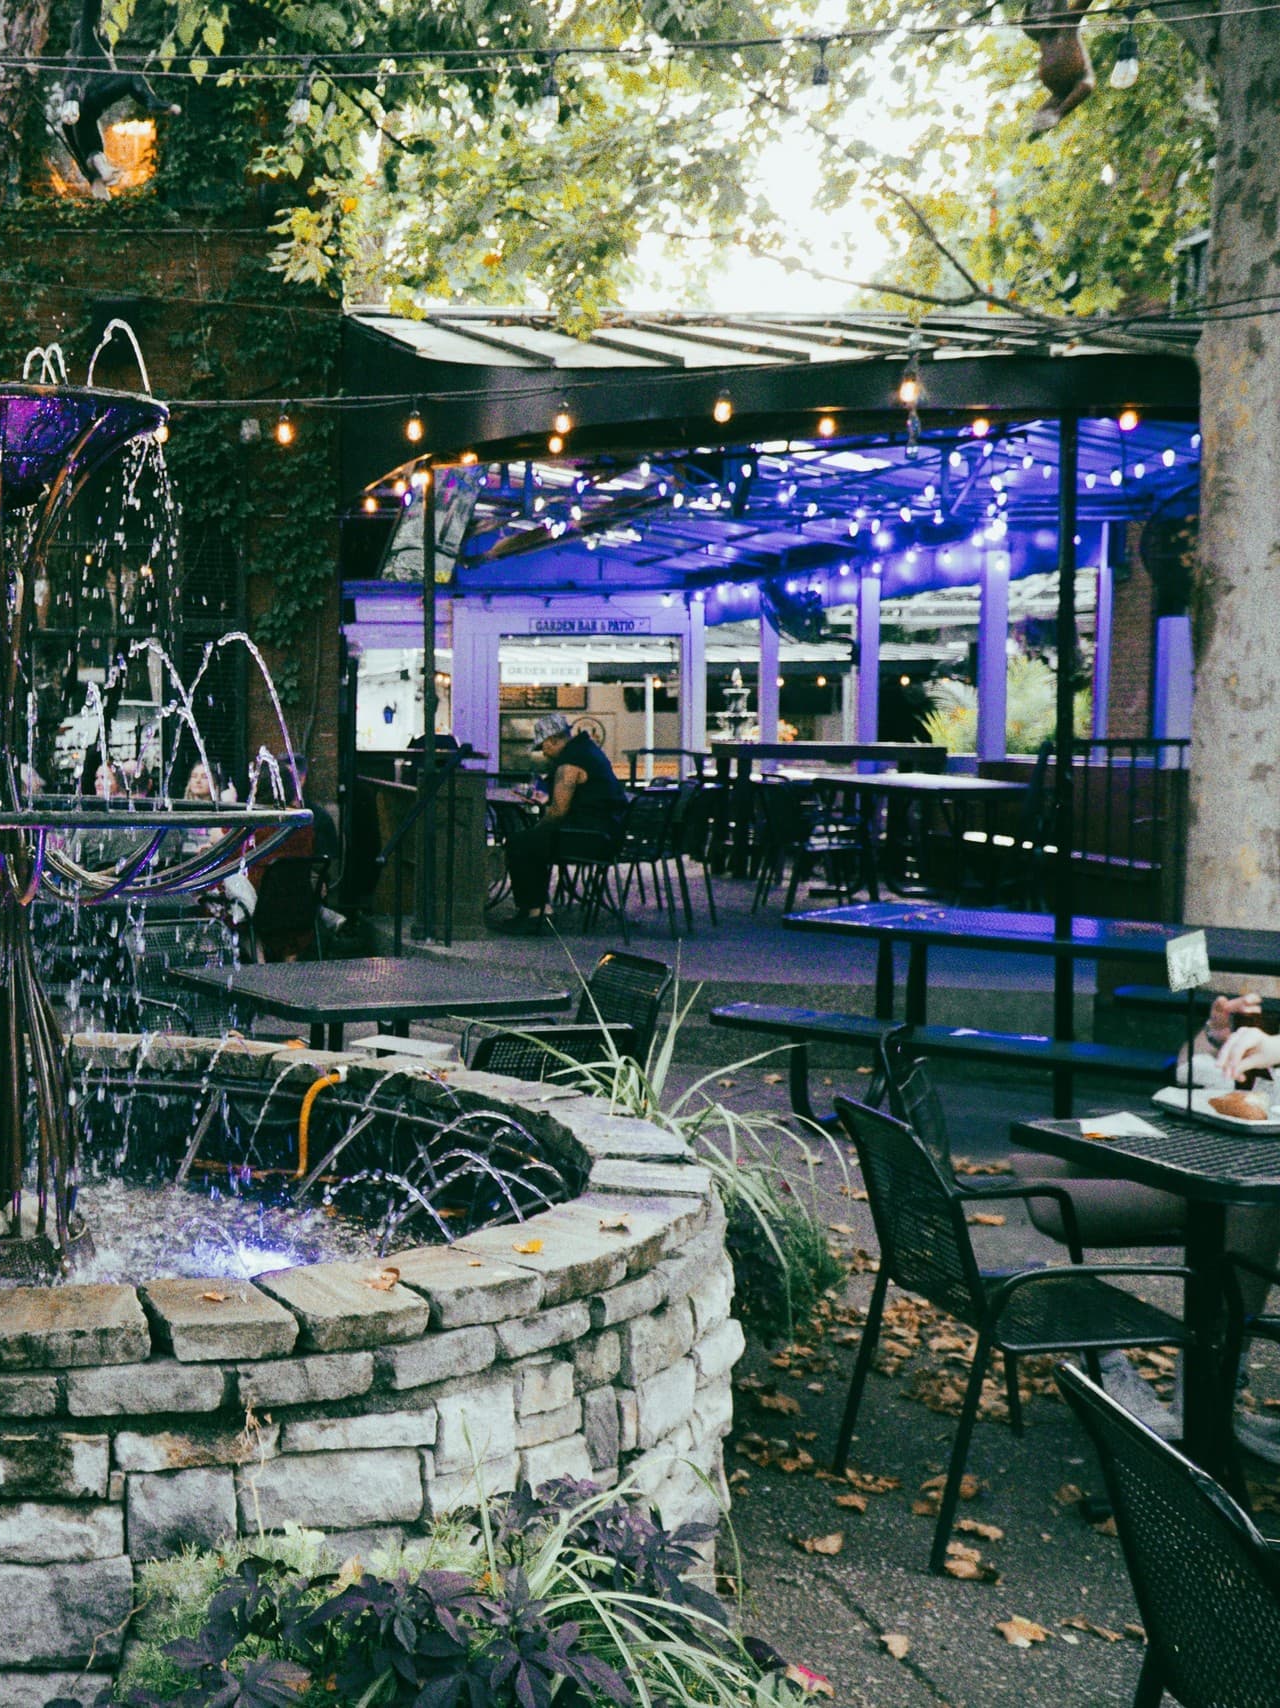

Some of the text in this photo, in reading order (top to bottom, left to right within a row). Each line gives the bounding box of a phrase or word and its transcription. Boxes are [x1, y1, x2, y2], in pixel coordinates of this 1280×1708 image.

[535, 620, 576, 632] GARDEN
[577, 620, 598, 632] BAR
[608, 620, 635, 632] PATIO
[507, 666, 582, 676] ORDER HERE
